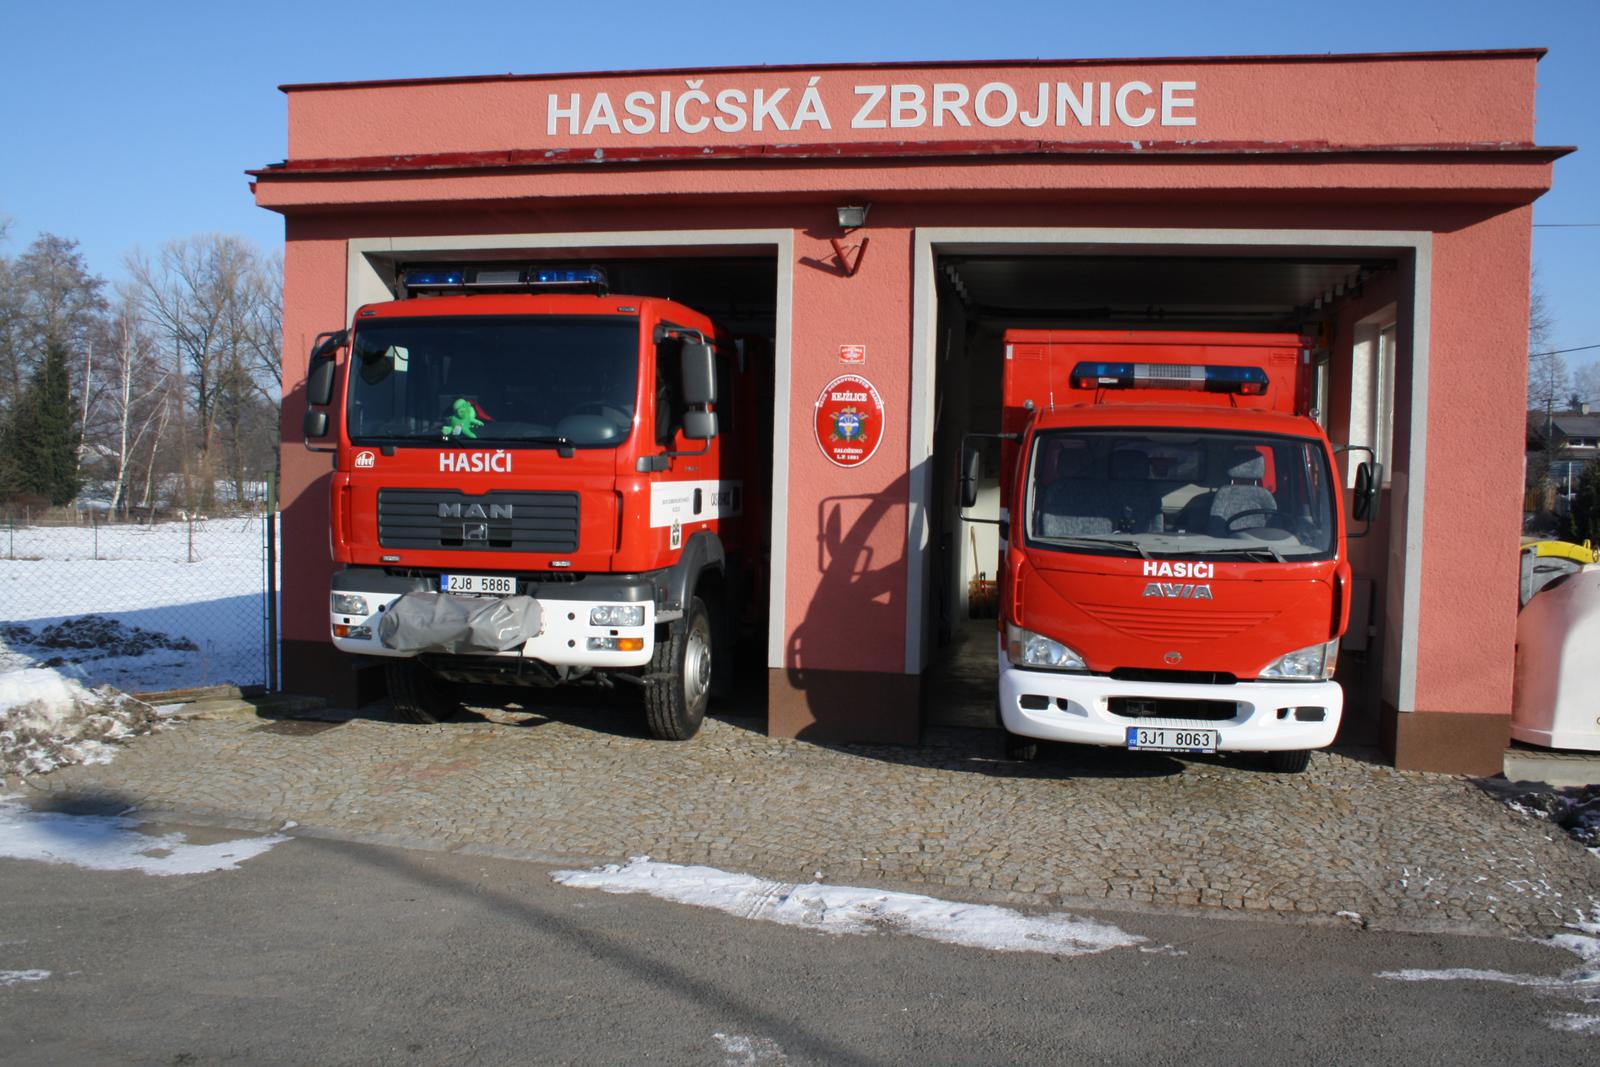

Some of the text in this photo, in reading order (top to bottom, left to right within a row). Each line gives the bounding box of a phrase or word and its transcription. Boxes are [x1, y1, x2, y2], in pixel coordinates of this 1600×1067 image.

[546, 76, 1198, 136] HASIČSKÁ ZBROJNICE
[439, 449, 512, 473] HASIČI
[438, 503, 513, 519] MAN
[1143, 561, 1214, 579] HASIČI
[450, 577, 472, 590] 2J8
[481, 578, 510, 592] 5886
[1143, 582, 1213, 600] AVIA
[1140, 731, 1210, 747] 3J1 8063
